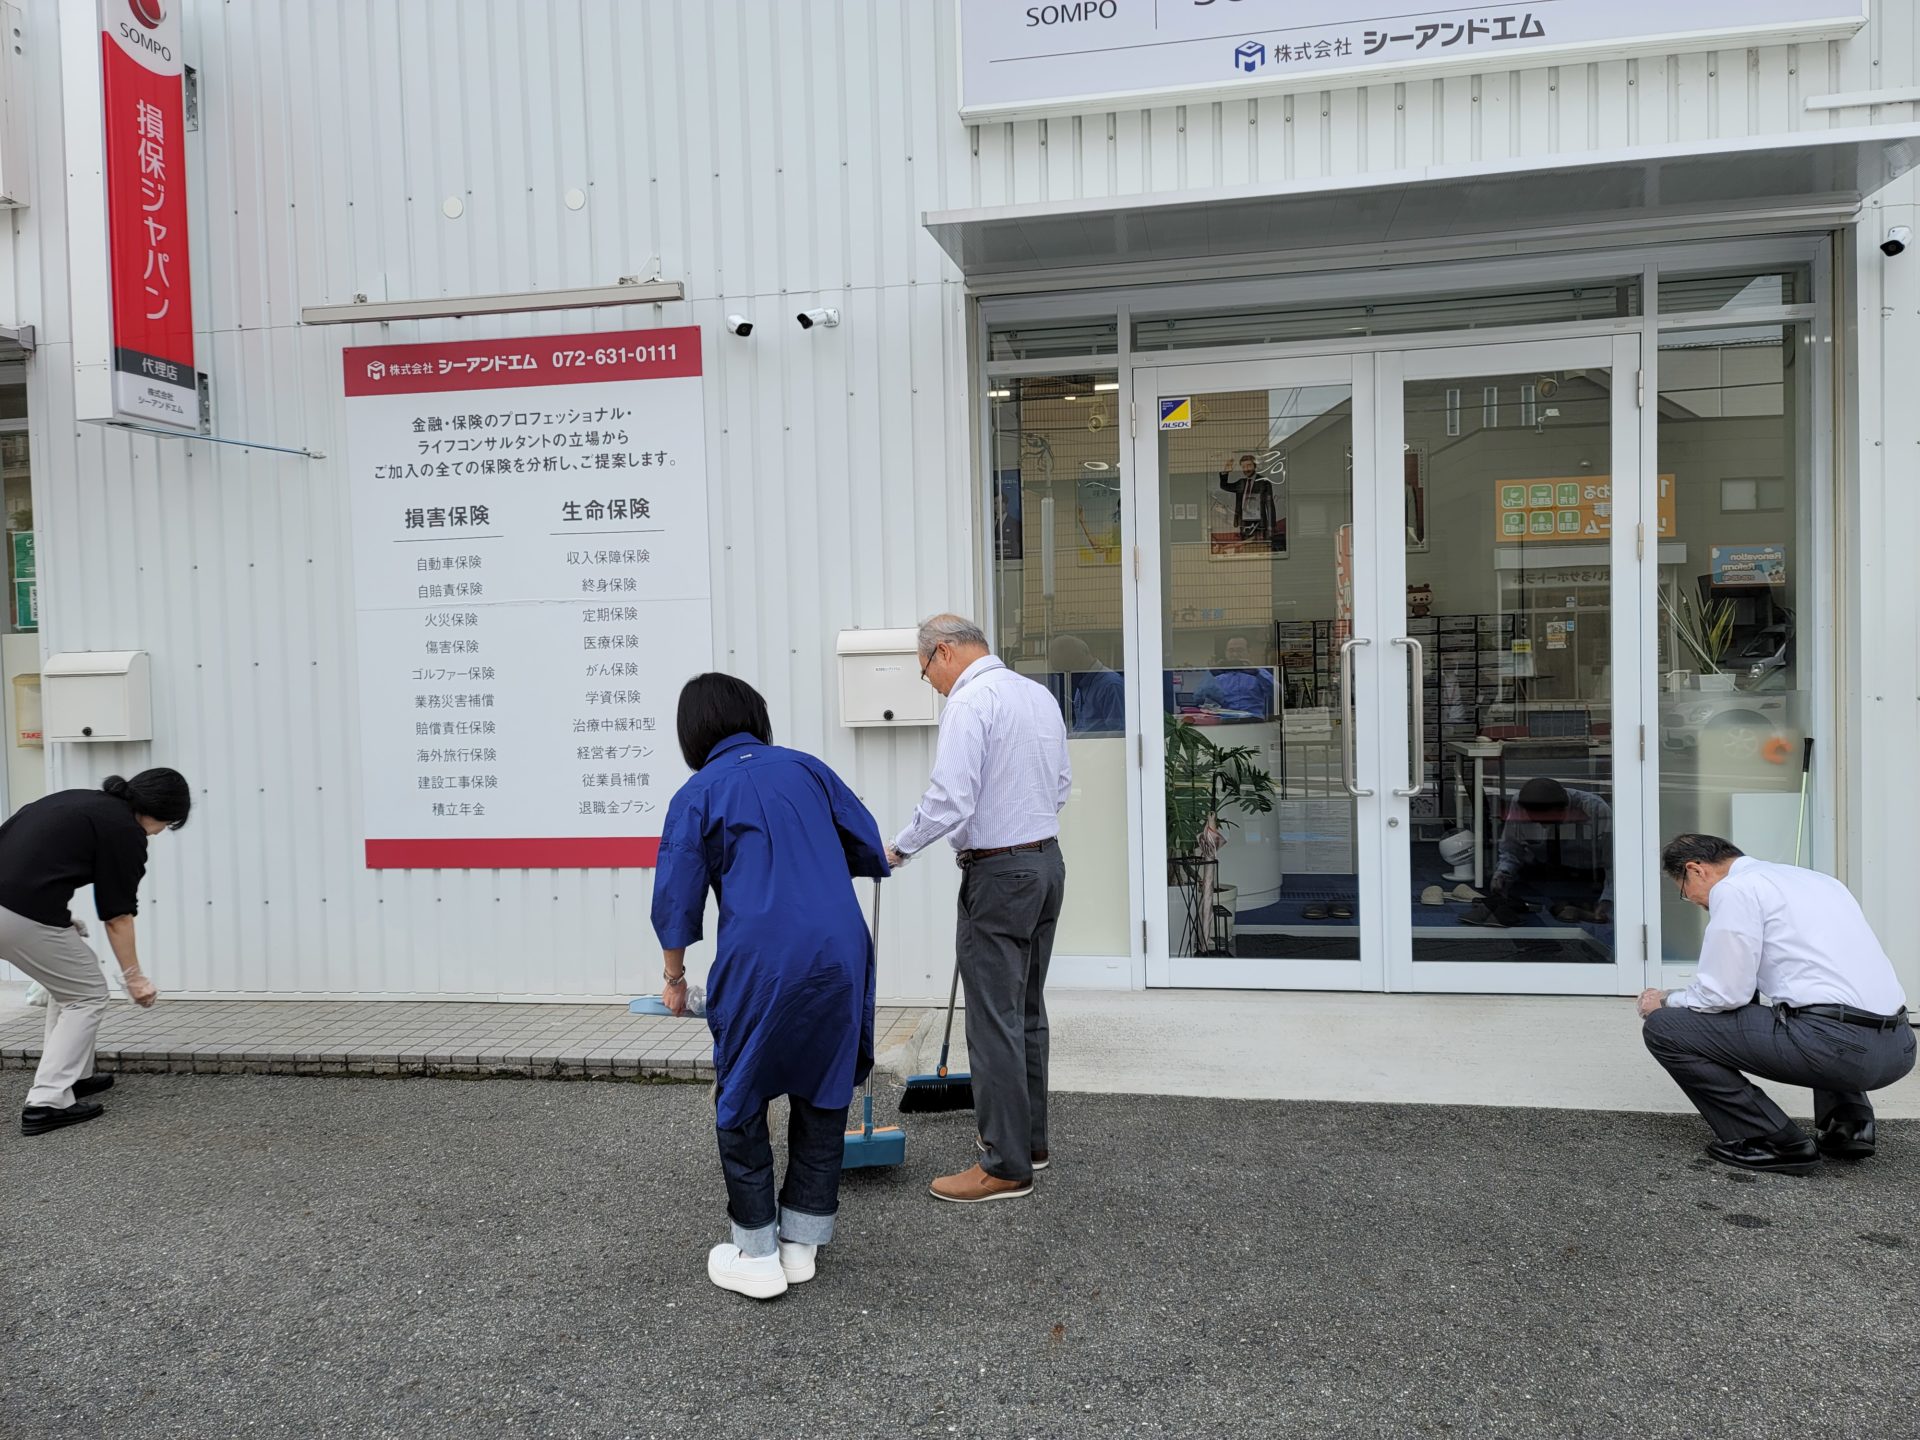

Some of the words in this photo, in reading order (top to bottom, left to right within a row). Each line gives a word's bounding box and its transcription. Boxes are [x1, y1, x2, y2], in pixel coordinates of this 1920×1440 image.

[1026, 0, 1117, 27] SOMPO
[119, 22, 172, 62] SOMPO
[1274, 36, 1353, 64] 株式会社
[1363, 13, 1546, 55] シーアンドエム
[136, 98, 170, 320] 損保ジャパン
[388, 362, 434, 376] 株式会社
[438, 354, 538, 375] シーアンドエム
[552, 344, 677, 368] 072-631-0111
[140, 357, 177, 383] 代理店
[147, 387, 174, 401] 株式会社
[138, 395, 184, 414] シーアンドエム
[417, 429, 630, 456] ライフコンサルタントの立場から
[374, 450, 677, 480] ご加入の全ての保険を分析し、ご提案します。
[404, 504, 490, 529] 損害保険
[562, 497, 651, 522] 生命保険
[416, 554, 482, 572] 自動車保険
[565, 548, 650, 565] 収入保障保険
[417, 582, 483, 599] 自賠責保険
[581, 577, 637, 593] 終身保険
[424, 612, 478, 627] 火災保険
[581, 606, 638, 623] 定期保険
[424, 639, 479, 654] 傷害保険
[582, 634, 639, 650] 医療保険
[411, 666, 495, 681] ゴルファー保険
[585, 662, 638, 677] がん保険
[414, 693, 495, 709] 業務災害補償
[584, 689, 641, 705] 学資保険
[414, 720, 496, 736] 賠償責任保険
[572, 717, 656, 733] 治療中緩和型
[415, 747, 497, 763] 海外旅行保険
[575, 744, 654, 760] 経営者プラン
[417, 775, 498, 790] 建設工事保険
[581, 772, 650, 788] 従業員補償
[431, 802, 485, 817] 積立年金
[578, 799, 655, 815] 退職金プラン
